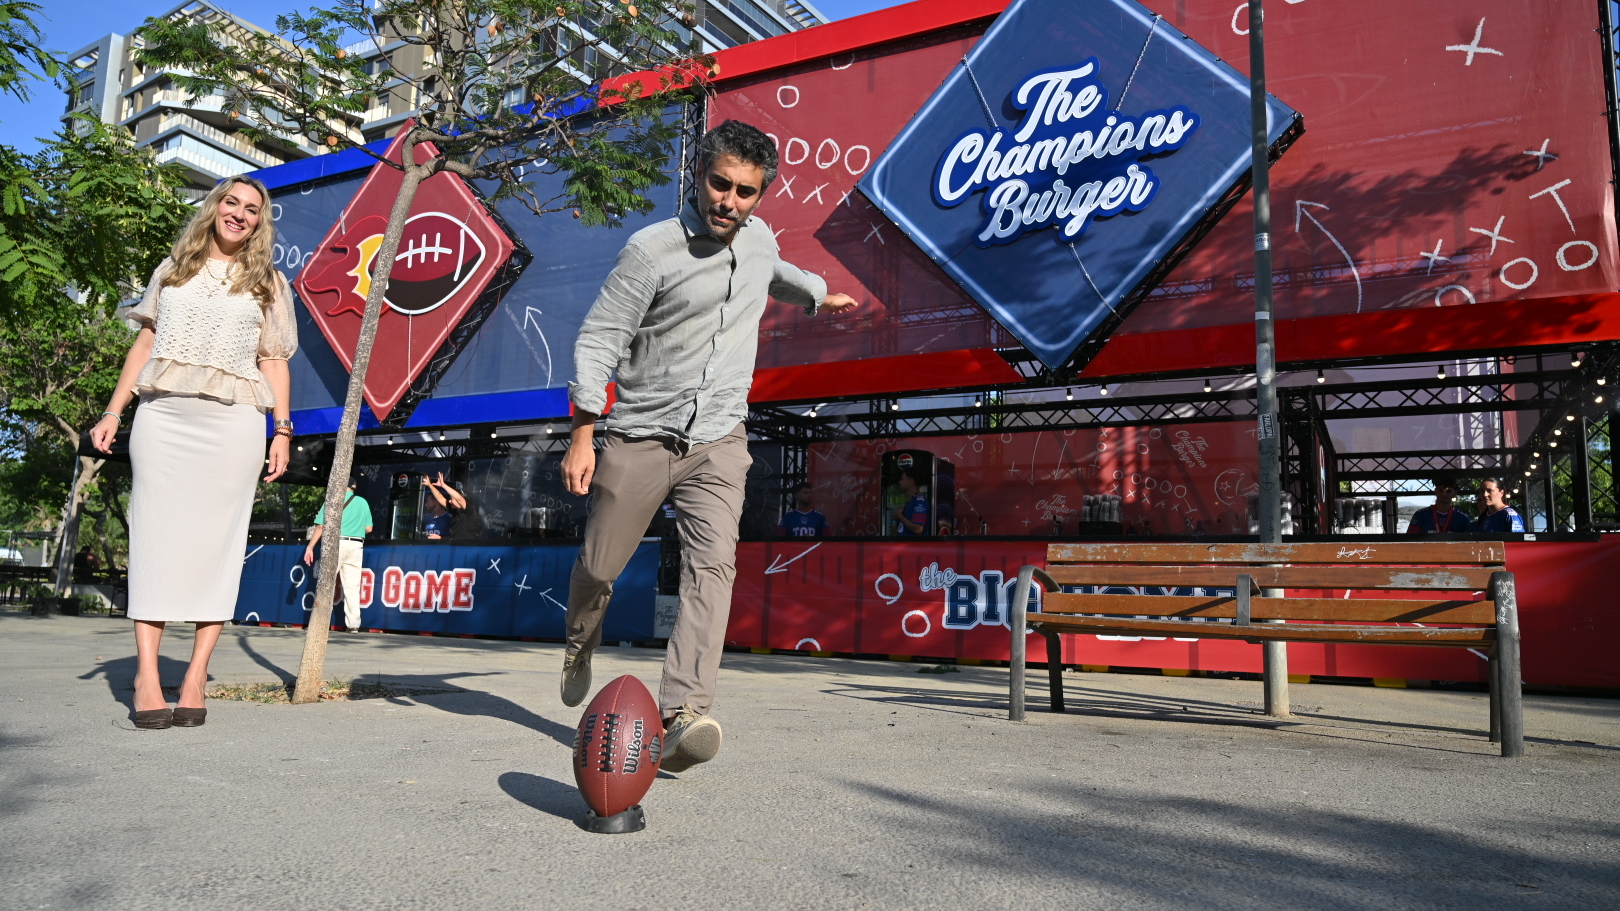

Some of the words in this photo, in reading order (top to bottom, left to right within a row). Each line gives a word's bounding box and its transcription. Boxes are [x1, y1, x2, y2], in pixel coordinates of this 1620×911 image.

[1017, 60, 1102, 143] The
[939, 109, 1194, 202] Champions
[978, 163, 1155, 242] Burger
[1171, 442, 1196, 468] Burger
[1175, 430, 1208, 469] Champions
[1190, 436, 1209, 451] The
[1040, 510, 1070, 523] Buger
[1051, 493, 1067, 505] The
[382, 566, 476, 613] GAME
[919, 562, 957, 591] the
[581, 712, 599, 769] Wilson
[622, 718, 644, 775] Wilson
